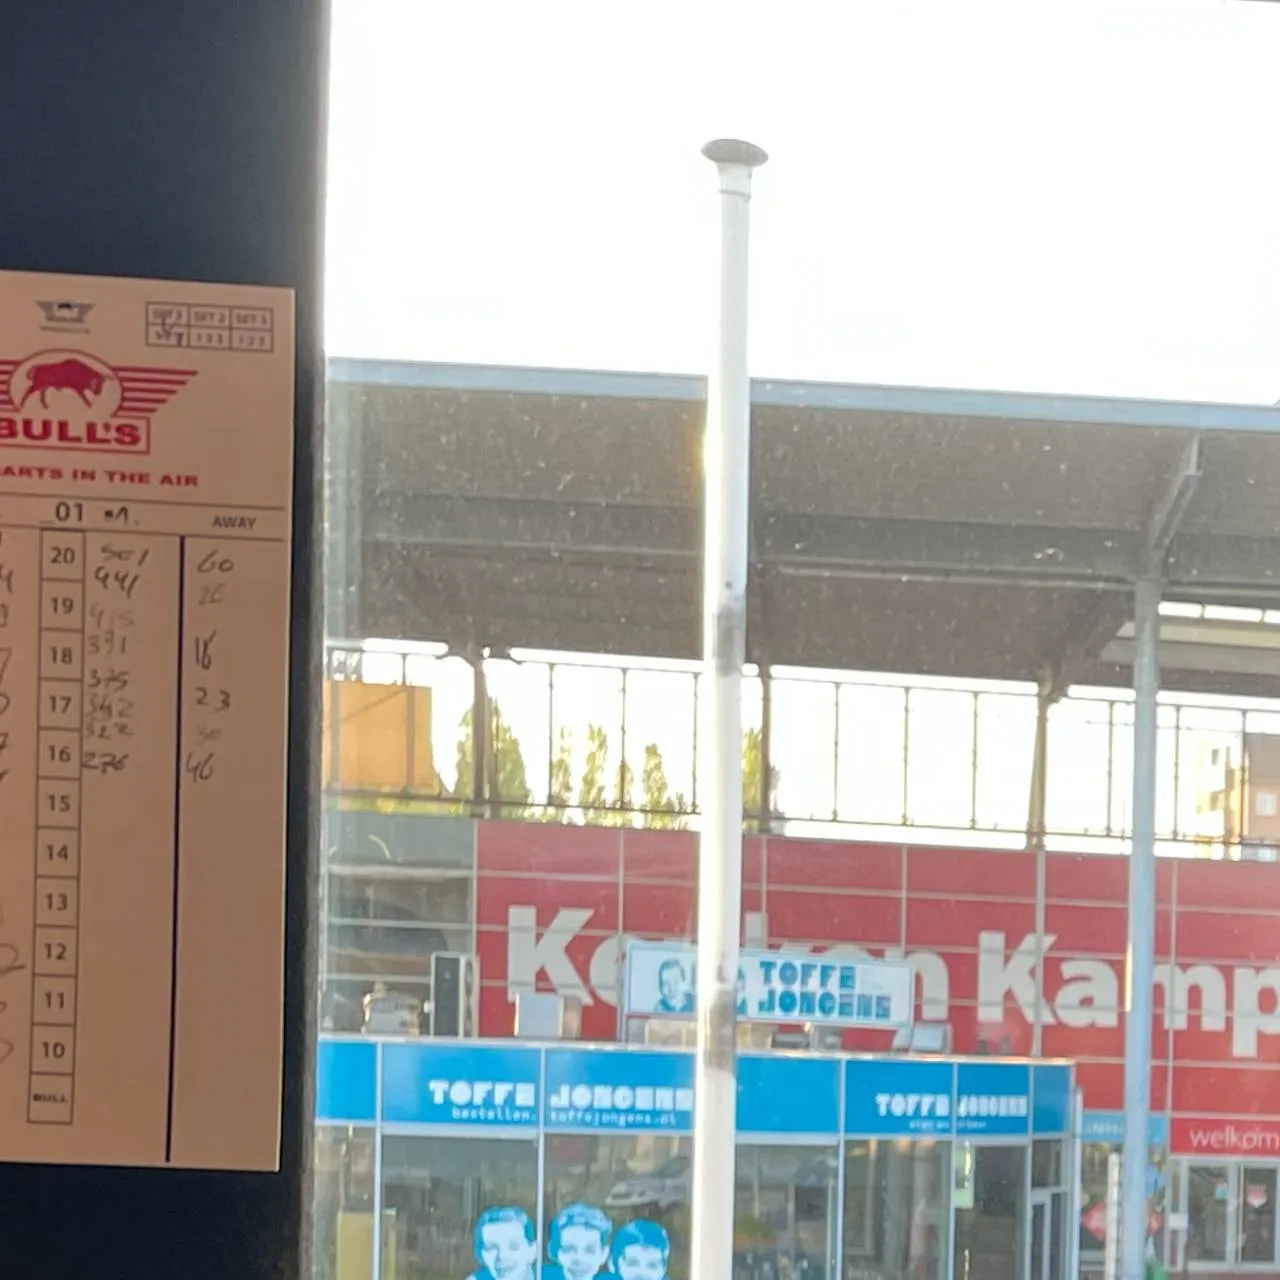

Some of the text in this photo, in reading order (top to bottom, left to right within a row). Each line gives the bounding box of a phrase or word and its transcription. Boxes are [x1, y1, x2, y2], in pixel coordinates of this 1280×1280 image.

[72, 468, 97, 482] IN
[104, 470, 150, 485] THE
[159, 473, 199, 487] AIR
[211, 515, 258, 529] AWAY
[50, 546, 76, 565] 20
[50, 596, 75, 615] 19
[49, 646, 73, 665] 18
[48, 695, 72, 714] 17
[47, 745, 72, 763] 16
[47, 794, 71, 812] 15
[46, 844, 70, 861] 14
[45, 893, 68, 911] 13
[44, 943, 67, 961] 12
[757, 959, 857, 990] TOFFE
[44, 992, 65, 1010] 11
[41, 1040, 66, 1059] 10
[428, 1079, 536, 1106] TOFFE
[1189, 1125, 1280, 1150] welkom
